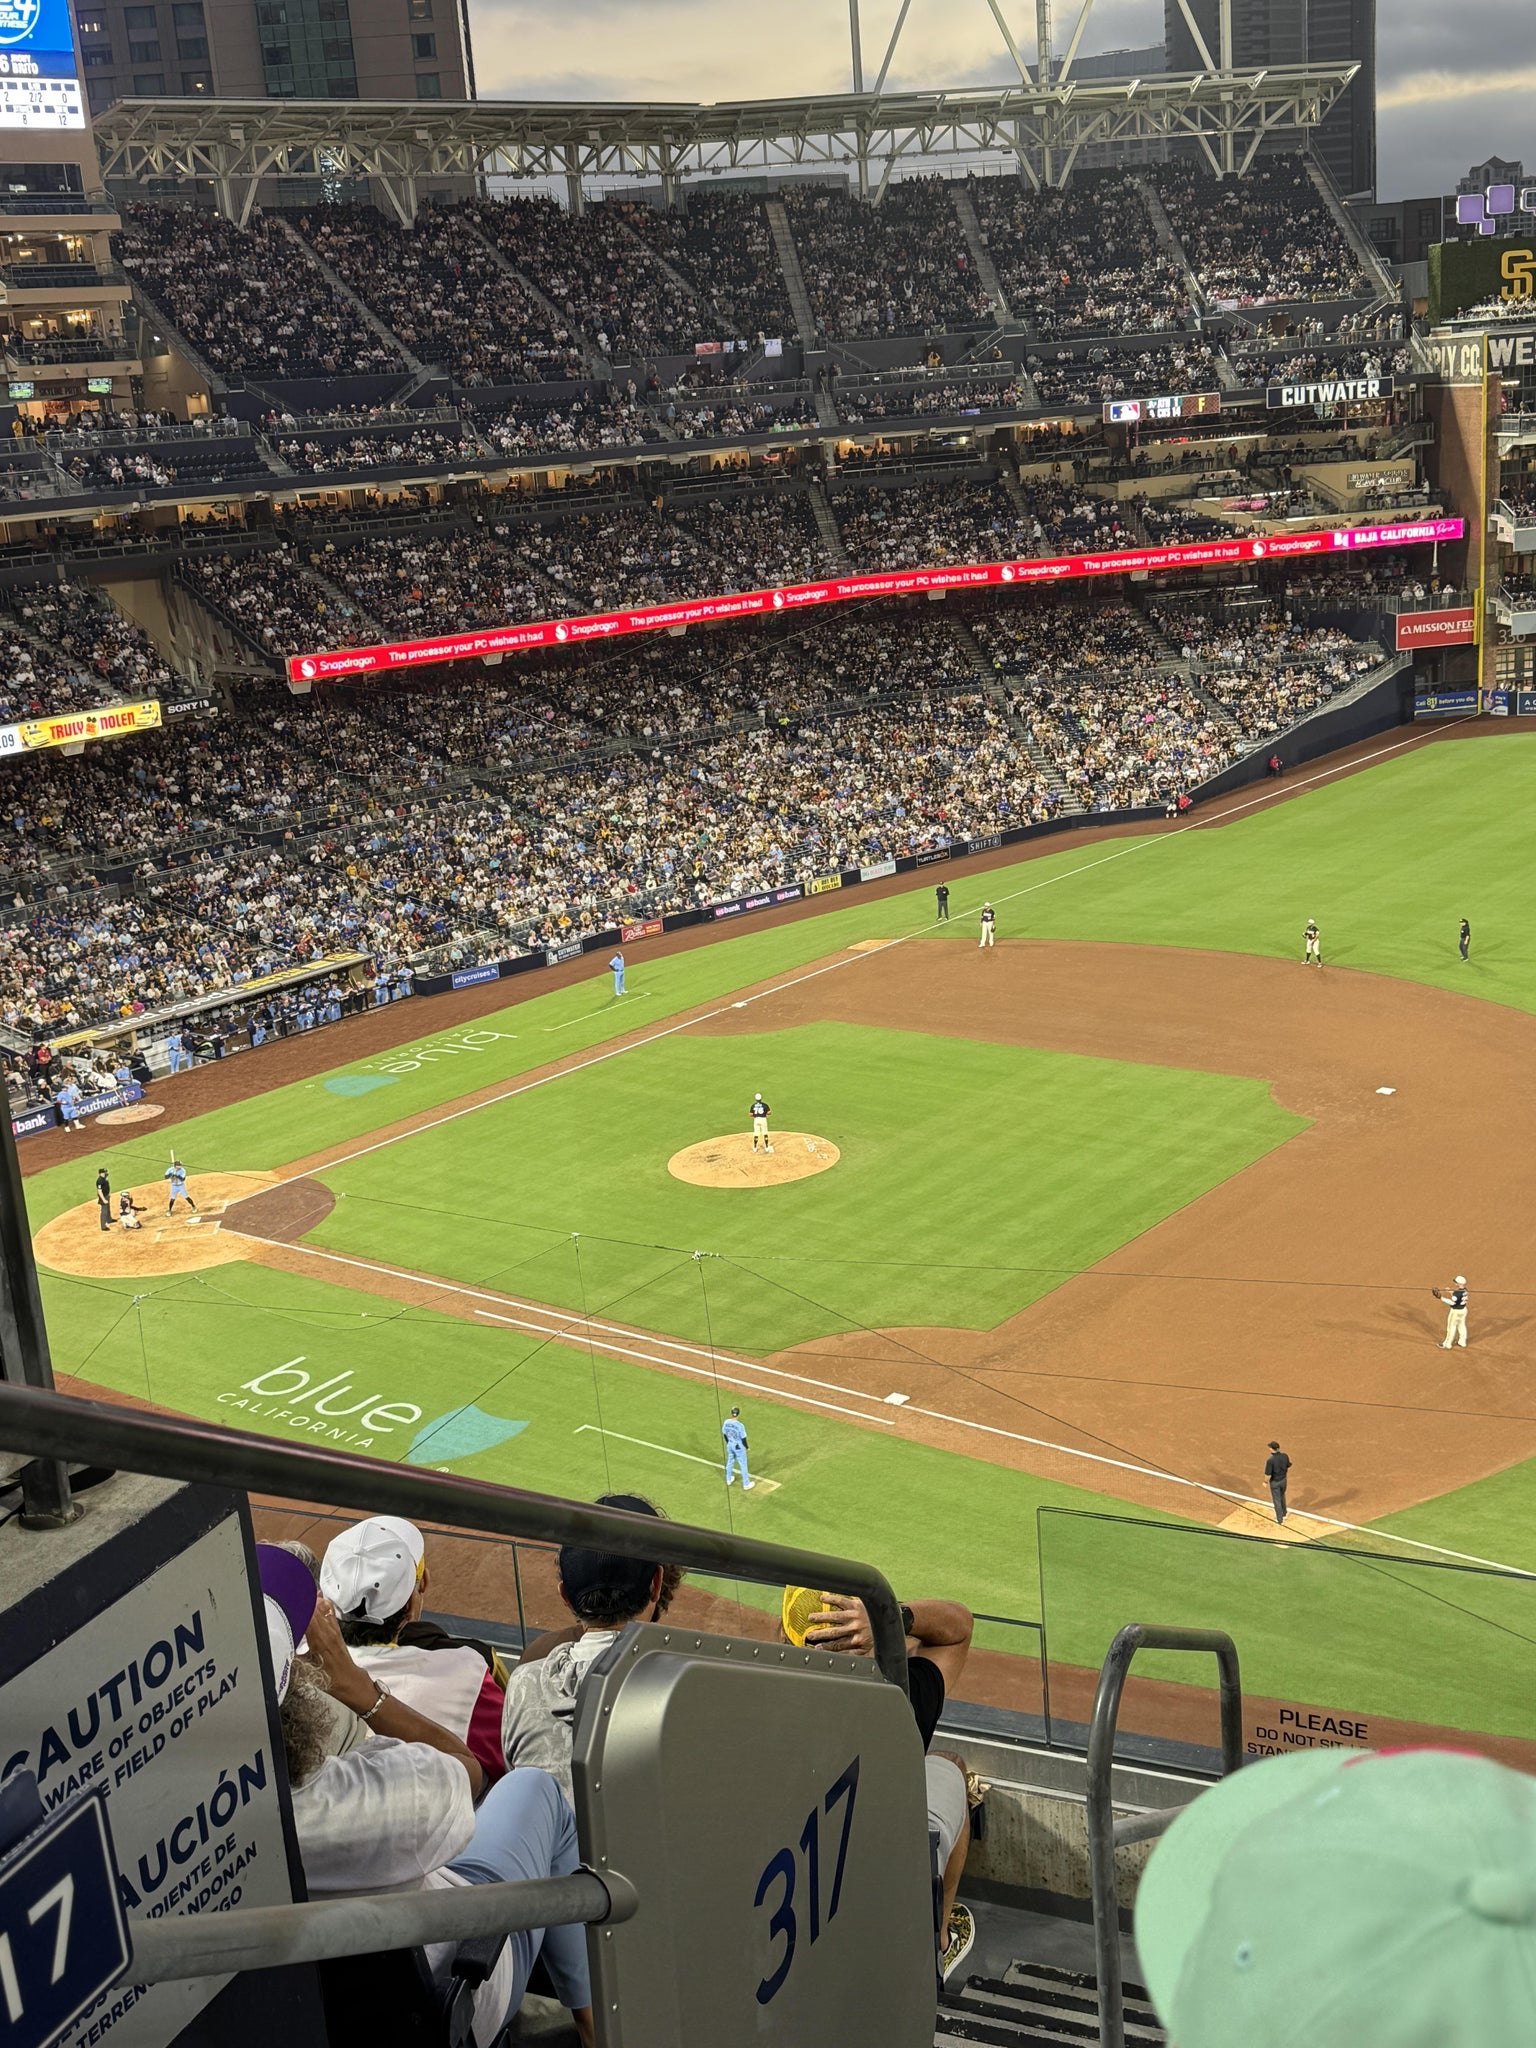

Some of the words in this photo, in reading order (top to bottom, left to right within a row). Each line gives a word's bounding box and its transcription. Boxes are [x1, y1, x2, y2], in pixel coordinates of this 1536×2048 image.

[1488, 335, 1536, 368] WE
[1198, 397, 1205, 412] F
[1281, 379, 1380, 406] CUTWATER
[1354, 531, 1379, 544] BAJA
[1380, 526, 1435, 541] CALIFORNIA
[320, 655, 376, 672] Snapdragon
[389, 651, 407, 663] The
[408, 646, 452, 661] processor
[454, 642, 473, 656] your
[474, 639, 488, 649] PC
[489, 635, 518, 647] wishes
[519, 633, 527, 643] it
[527, 631, 544, 642] had
[571, 621, 619, 636] Snapdragon
[630, 615, 646, 627] The
[646, 611, 685, 626] processor
[685, 608, 703, 622] your
[703, 605, 715, 615] PC
[715, 602, 742, 614] wishes
[742, 600, 749, 609] it
[748, 598, 763, 609] had
[786, 588, 828, 602] Snapdragon
[837, 585, 851, 595] The
[851, 580, 894, 593] processor
[895, 577, 914, 589] your
[916, 574, 930, 585] PC
[930, 572, 962, 584] wishes
[963, 571, 970, 581] it
[970, 570, 988, 580] had
[1018, 563, 1070, 577] Snapdragon
[1083, 560, 1101, 571] The
[1102, 555, 1146, 568] processor
[1147, 553, 1166, 566] your
[1168, 551, 1181, 561] PC
[1182, 549, 1214, 561] wishes
[1214, 547, 1221, 557] it
[1222, 546, 1240, 557] had
[1269, 538, 1321, 552] Snapdragon
[1412, 621, 1455, 635] MISSION
[1456, 620, 1475, 629] FED
[168, 701, 198, 714] SONY
[1426, 697, 1438, 706] 811
[50, 721, 84, 740] TRULY
[99, 712, 136, 731] NOLEN
[454, 971, 491, 984] citycruises
[240, 1356, 422, 1432] blue
[216, 1393, 375, 1449] CALIFORNIA
[1, 1610, 205, 1784] CAUTION
[108, 1725, 134, 1759] OF
[139, 1658, 217, 1734] OBJECTS
[114, 1733, 166, 1788] FIELD
[170, 1706, 193, 1739] OF
[199, 1667, 239, 1717] PLAY
[1256, 1727, 1278, 1741] DO
[1283, 1731, 1316, 1748] NOT
[1279, 1708, 1368, 1740] PLEASE
[1247, 1742, 1295, 1757] STAN
[214, 1832, 237, 1865] DE
[178, 1841, 258, 1916] NDONAN
[753, 1754, 860, 2005] 317
[0, 1872, 75, 2024] 17
[76, 1983, 157, 2048] TERREN
